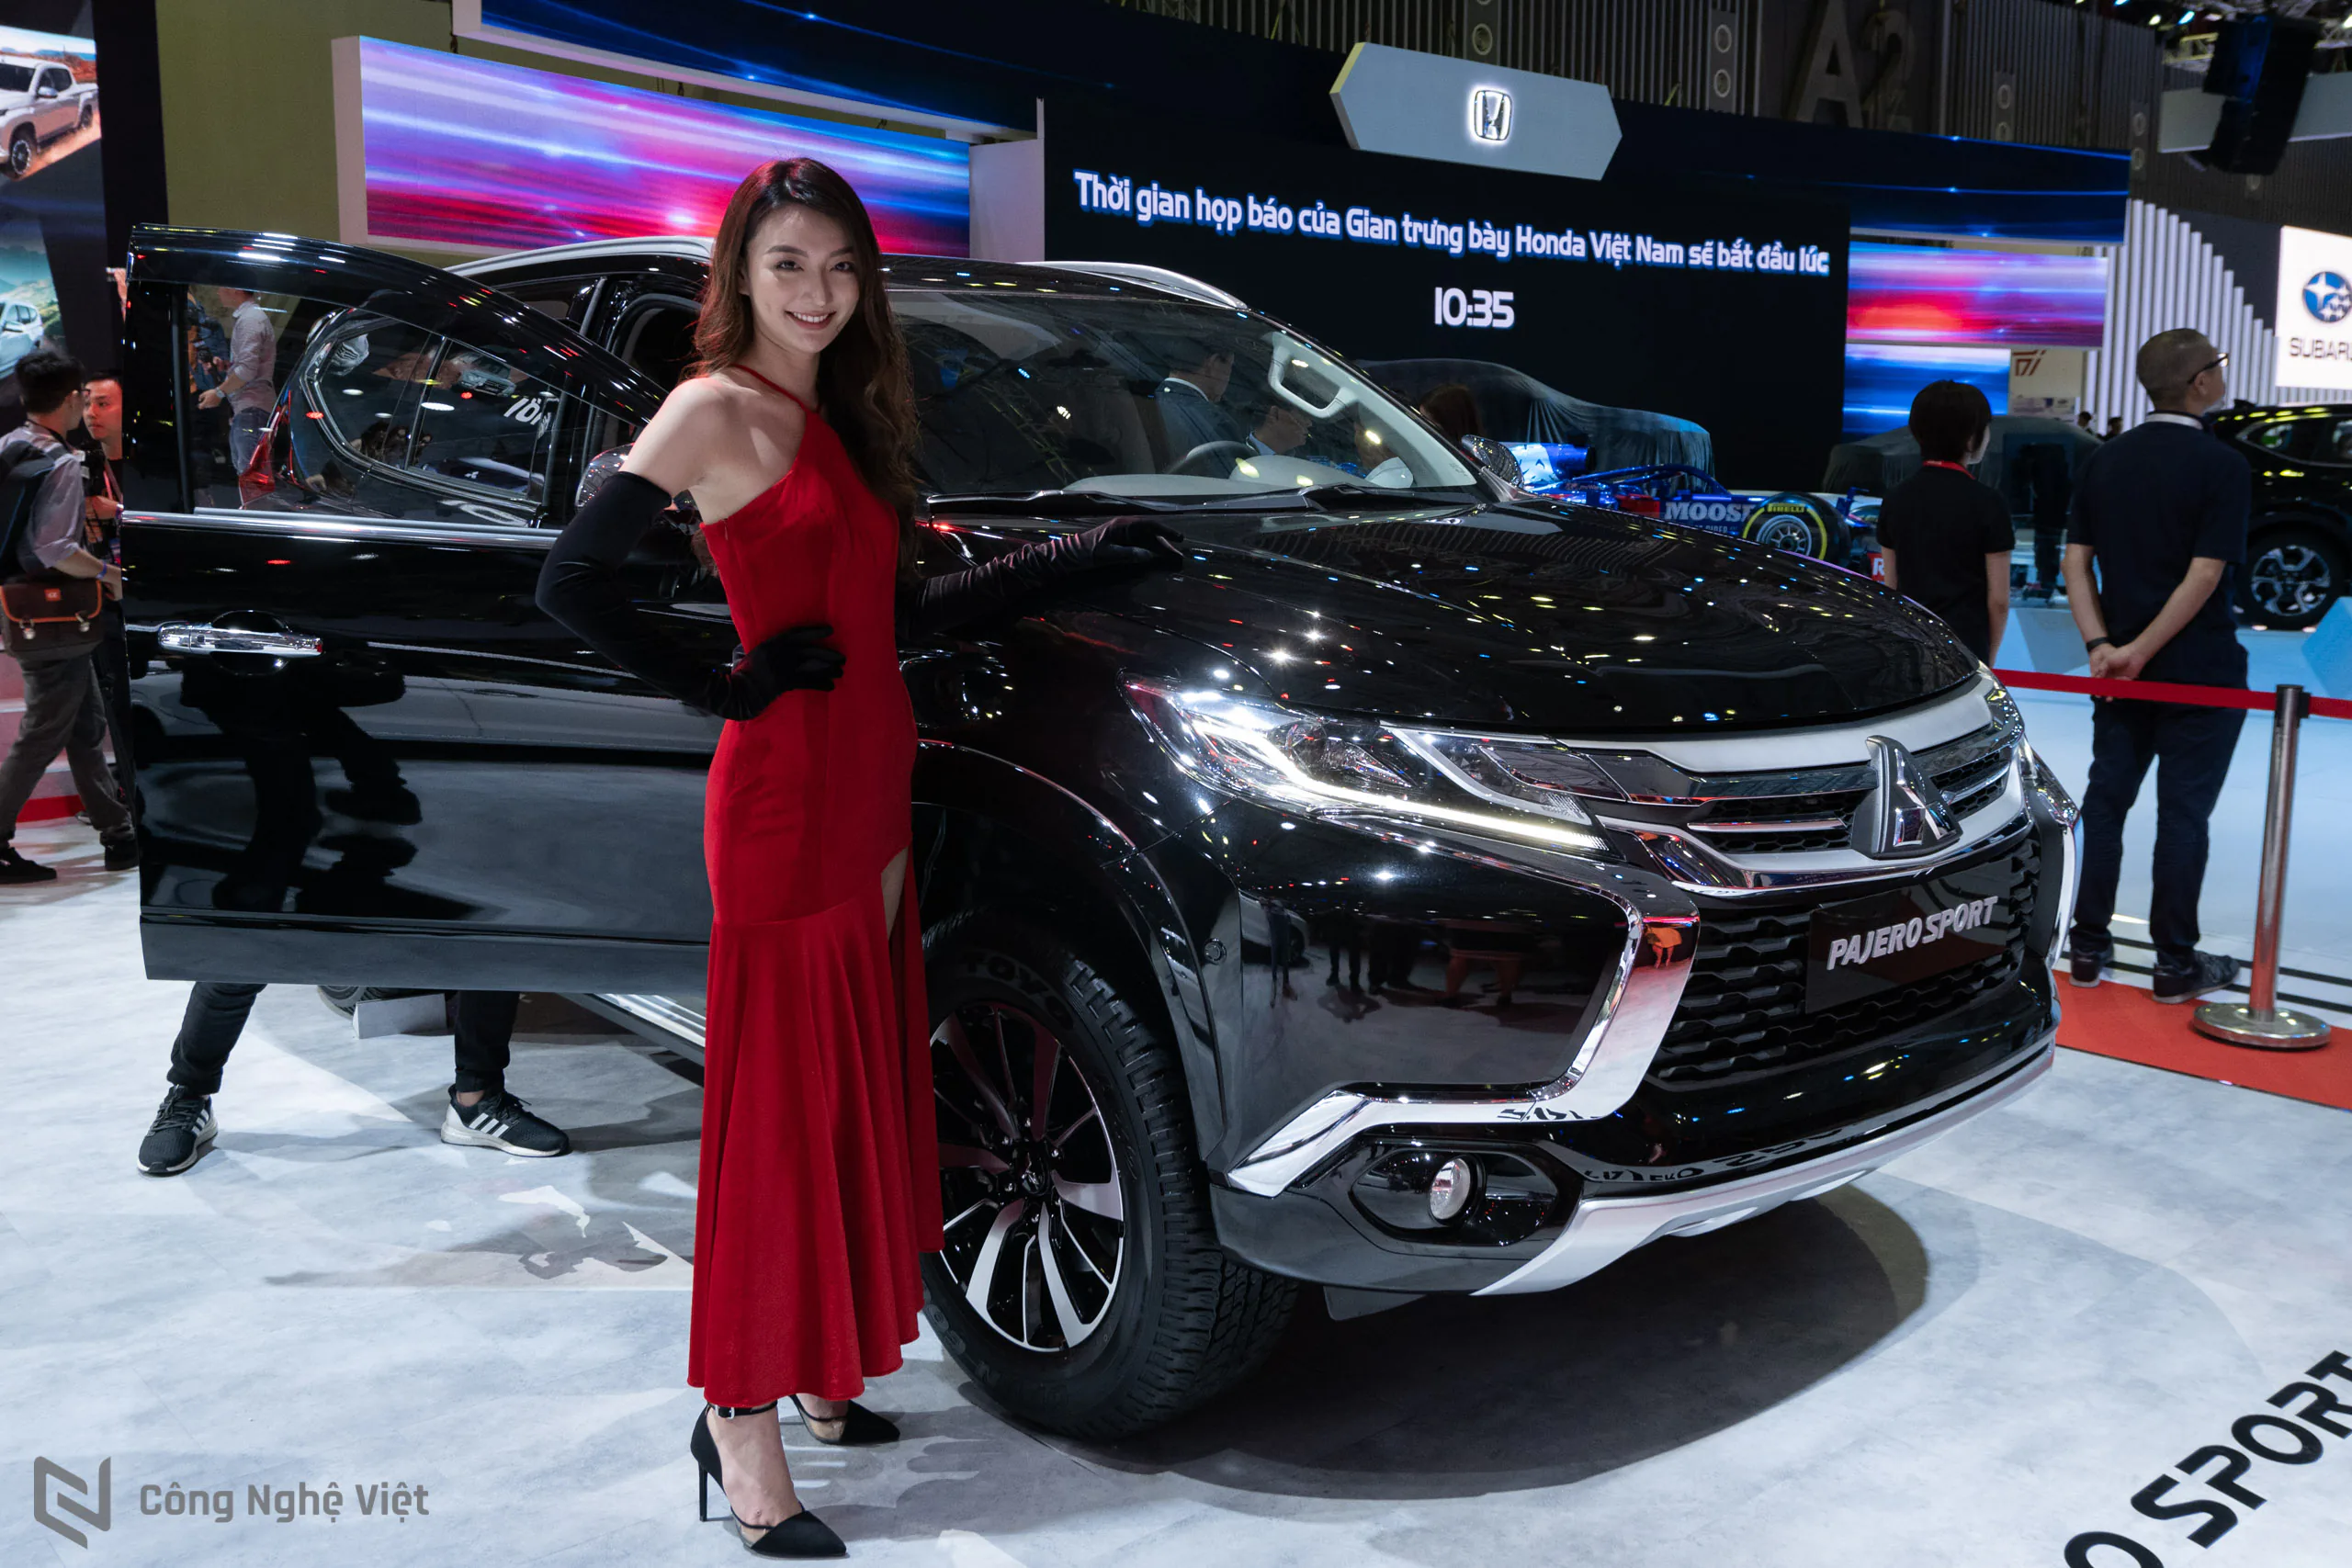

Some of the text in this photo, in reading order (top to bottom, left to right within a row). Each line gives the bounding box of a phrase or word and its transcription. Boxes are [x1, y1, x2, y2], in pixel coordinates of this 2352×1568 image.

[1074, 170, 1829, 274] Thời gian họp báo của Gian trưng bày Honda Việt Nam sẽ bắt đầu lúc
[1434, 287, 1515, 329] 10:35
[2289, 336, 2352, 362] SUBAR
[1826, 896, 1999, 971] PAJERO SPORT
